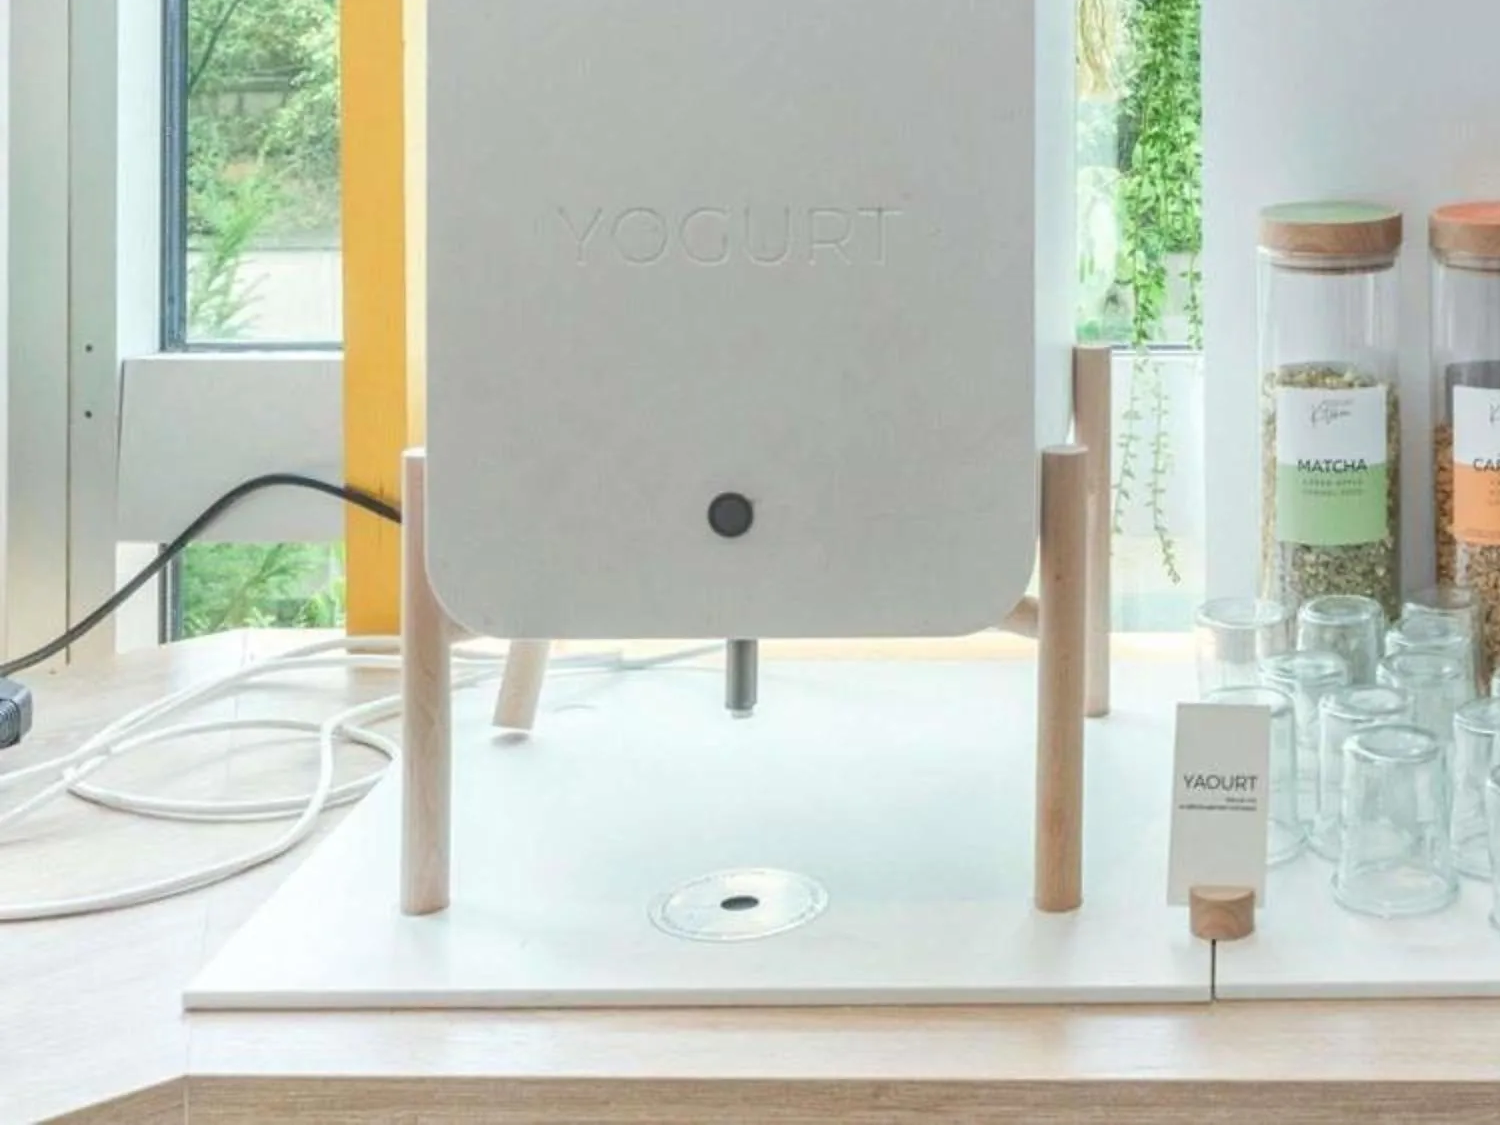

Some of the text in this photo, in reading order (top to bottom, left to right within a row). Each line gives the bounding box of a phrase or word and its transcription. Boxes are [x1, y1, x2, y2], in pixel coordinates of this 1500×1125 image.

[557, 205, 903, 266] YOGURT
[1297, 458, 1368, 474] MATCHA
[1182, 774, 1258, 792] YAOURT
